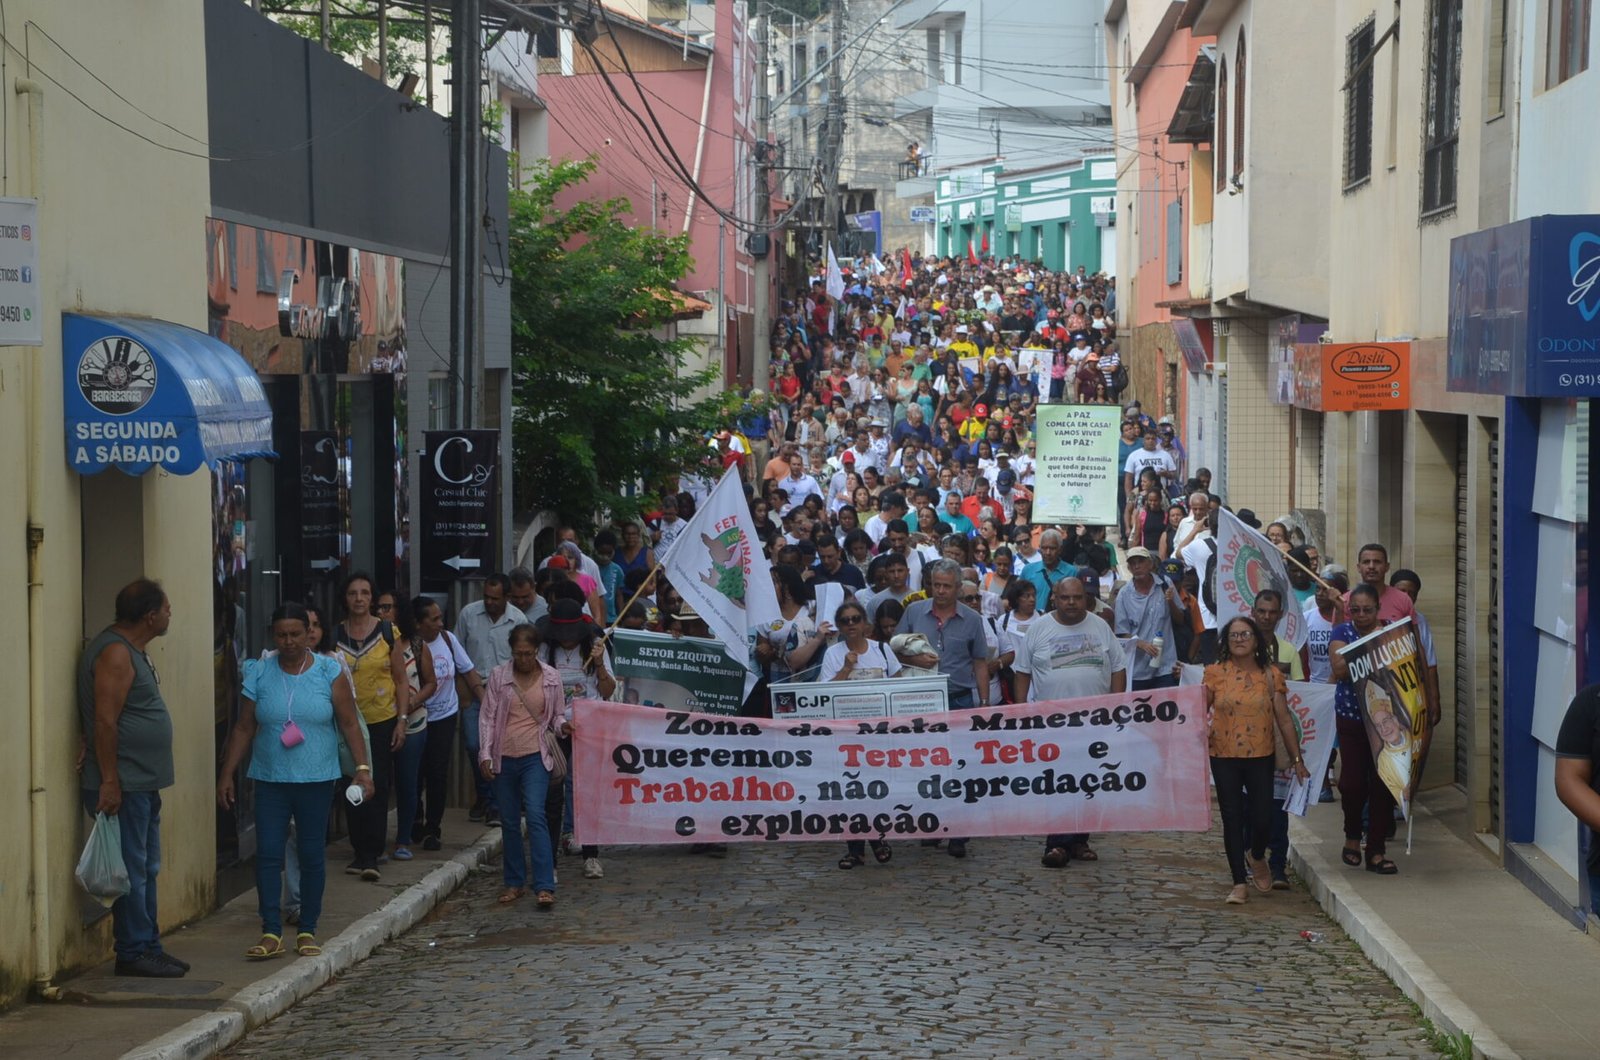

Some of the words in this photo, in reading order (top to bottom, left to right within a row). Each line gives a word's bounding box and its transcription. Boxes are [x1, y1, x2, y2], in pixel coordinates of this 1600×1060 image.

[1574, 374, 1595, 387] (31)
[1074, 411, 1091, 419] PAZ
[76, 421, 178, 439] SEGUNDA
[75, 447, 90, 464] A
[96, 441, 180, 463] SÁBADO
[1139, 458, 1163, 466] VANS
[638, 646, 675, 659] SETOR
[676, 651, 721, 664] ZIQUITO
[1349, 654, 1374, 683] DOM
[1373, 631, 1418, 670] LUCIANO
[631, 658, 660, 669] Mateus,
[660, 661, 682, 670] Santa
[682, 663, 702, 673] Rosa,
[694, 690, 718, 699] Viveu
[797, 695, 830, 708] CJP
[686, 699, 708, 707] fazer
[716, 702, 738, 711] bem,
[665, 712, 763, 736] Zona
[787, 722, 834, 737] da
[856, 717, 950, 735] Mata
[969, 695, 1187, 733] Mineração,
[1287, 692, 1316, 745] RASIL
[612, 744, 813, 774] Queremos
[838, 744, 967, 770] Terra,
[974, 738, 1061, 765] Teto
[1088, 740, 1109, 759] e
[613, 776, 807, 805] Trabalho,
[817, 770, 890, 801] não
[917, 761, 1147, 804] depredação
[675, 815, 697, 837] e
[720, 803, 949, 841] exploração.
